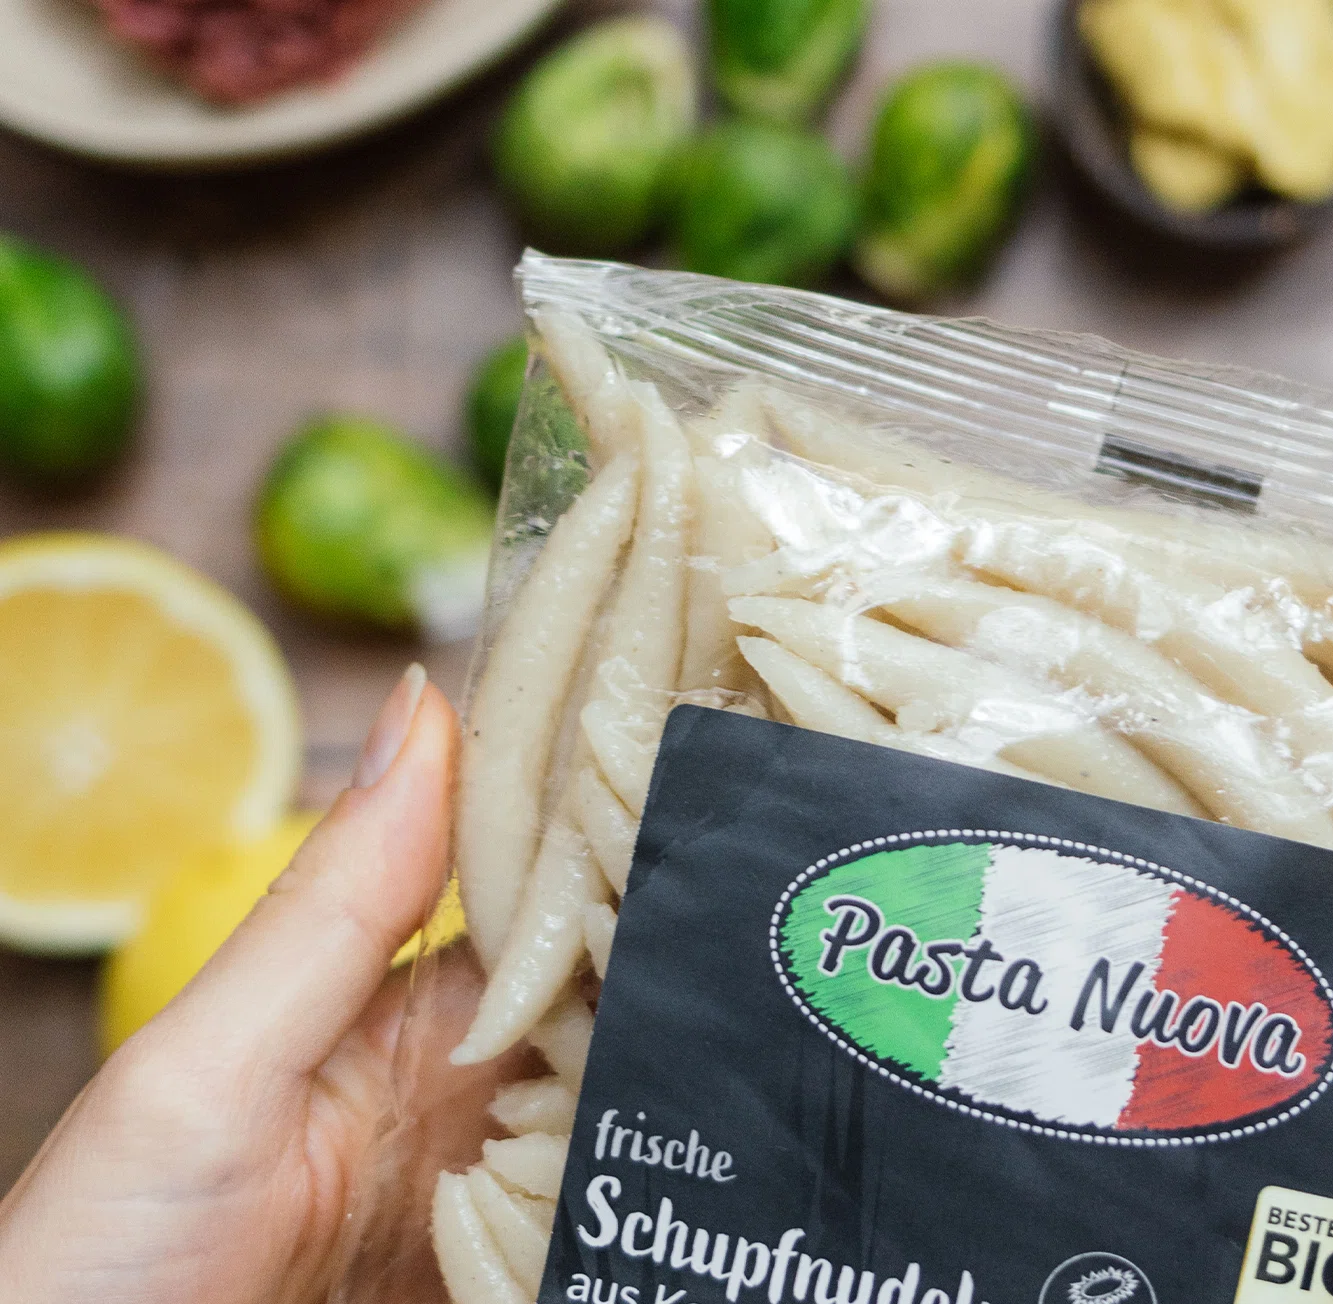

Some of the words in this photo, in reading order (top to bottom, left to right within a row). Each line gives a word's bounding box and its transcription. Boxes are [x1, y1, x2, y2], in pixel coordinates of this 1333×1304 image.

[820, 897, 1049, 1018] Pasta
[1069, 959, 1306, 1077] Nuova
[594, 1109, 736, 1182] frische
